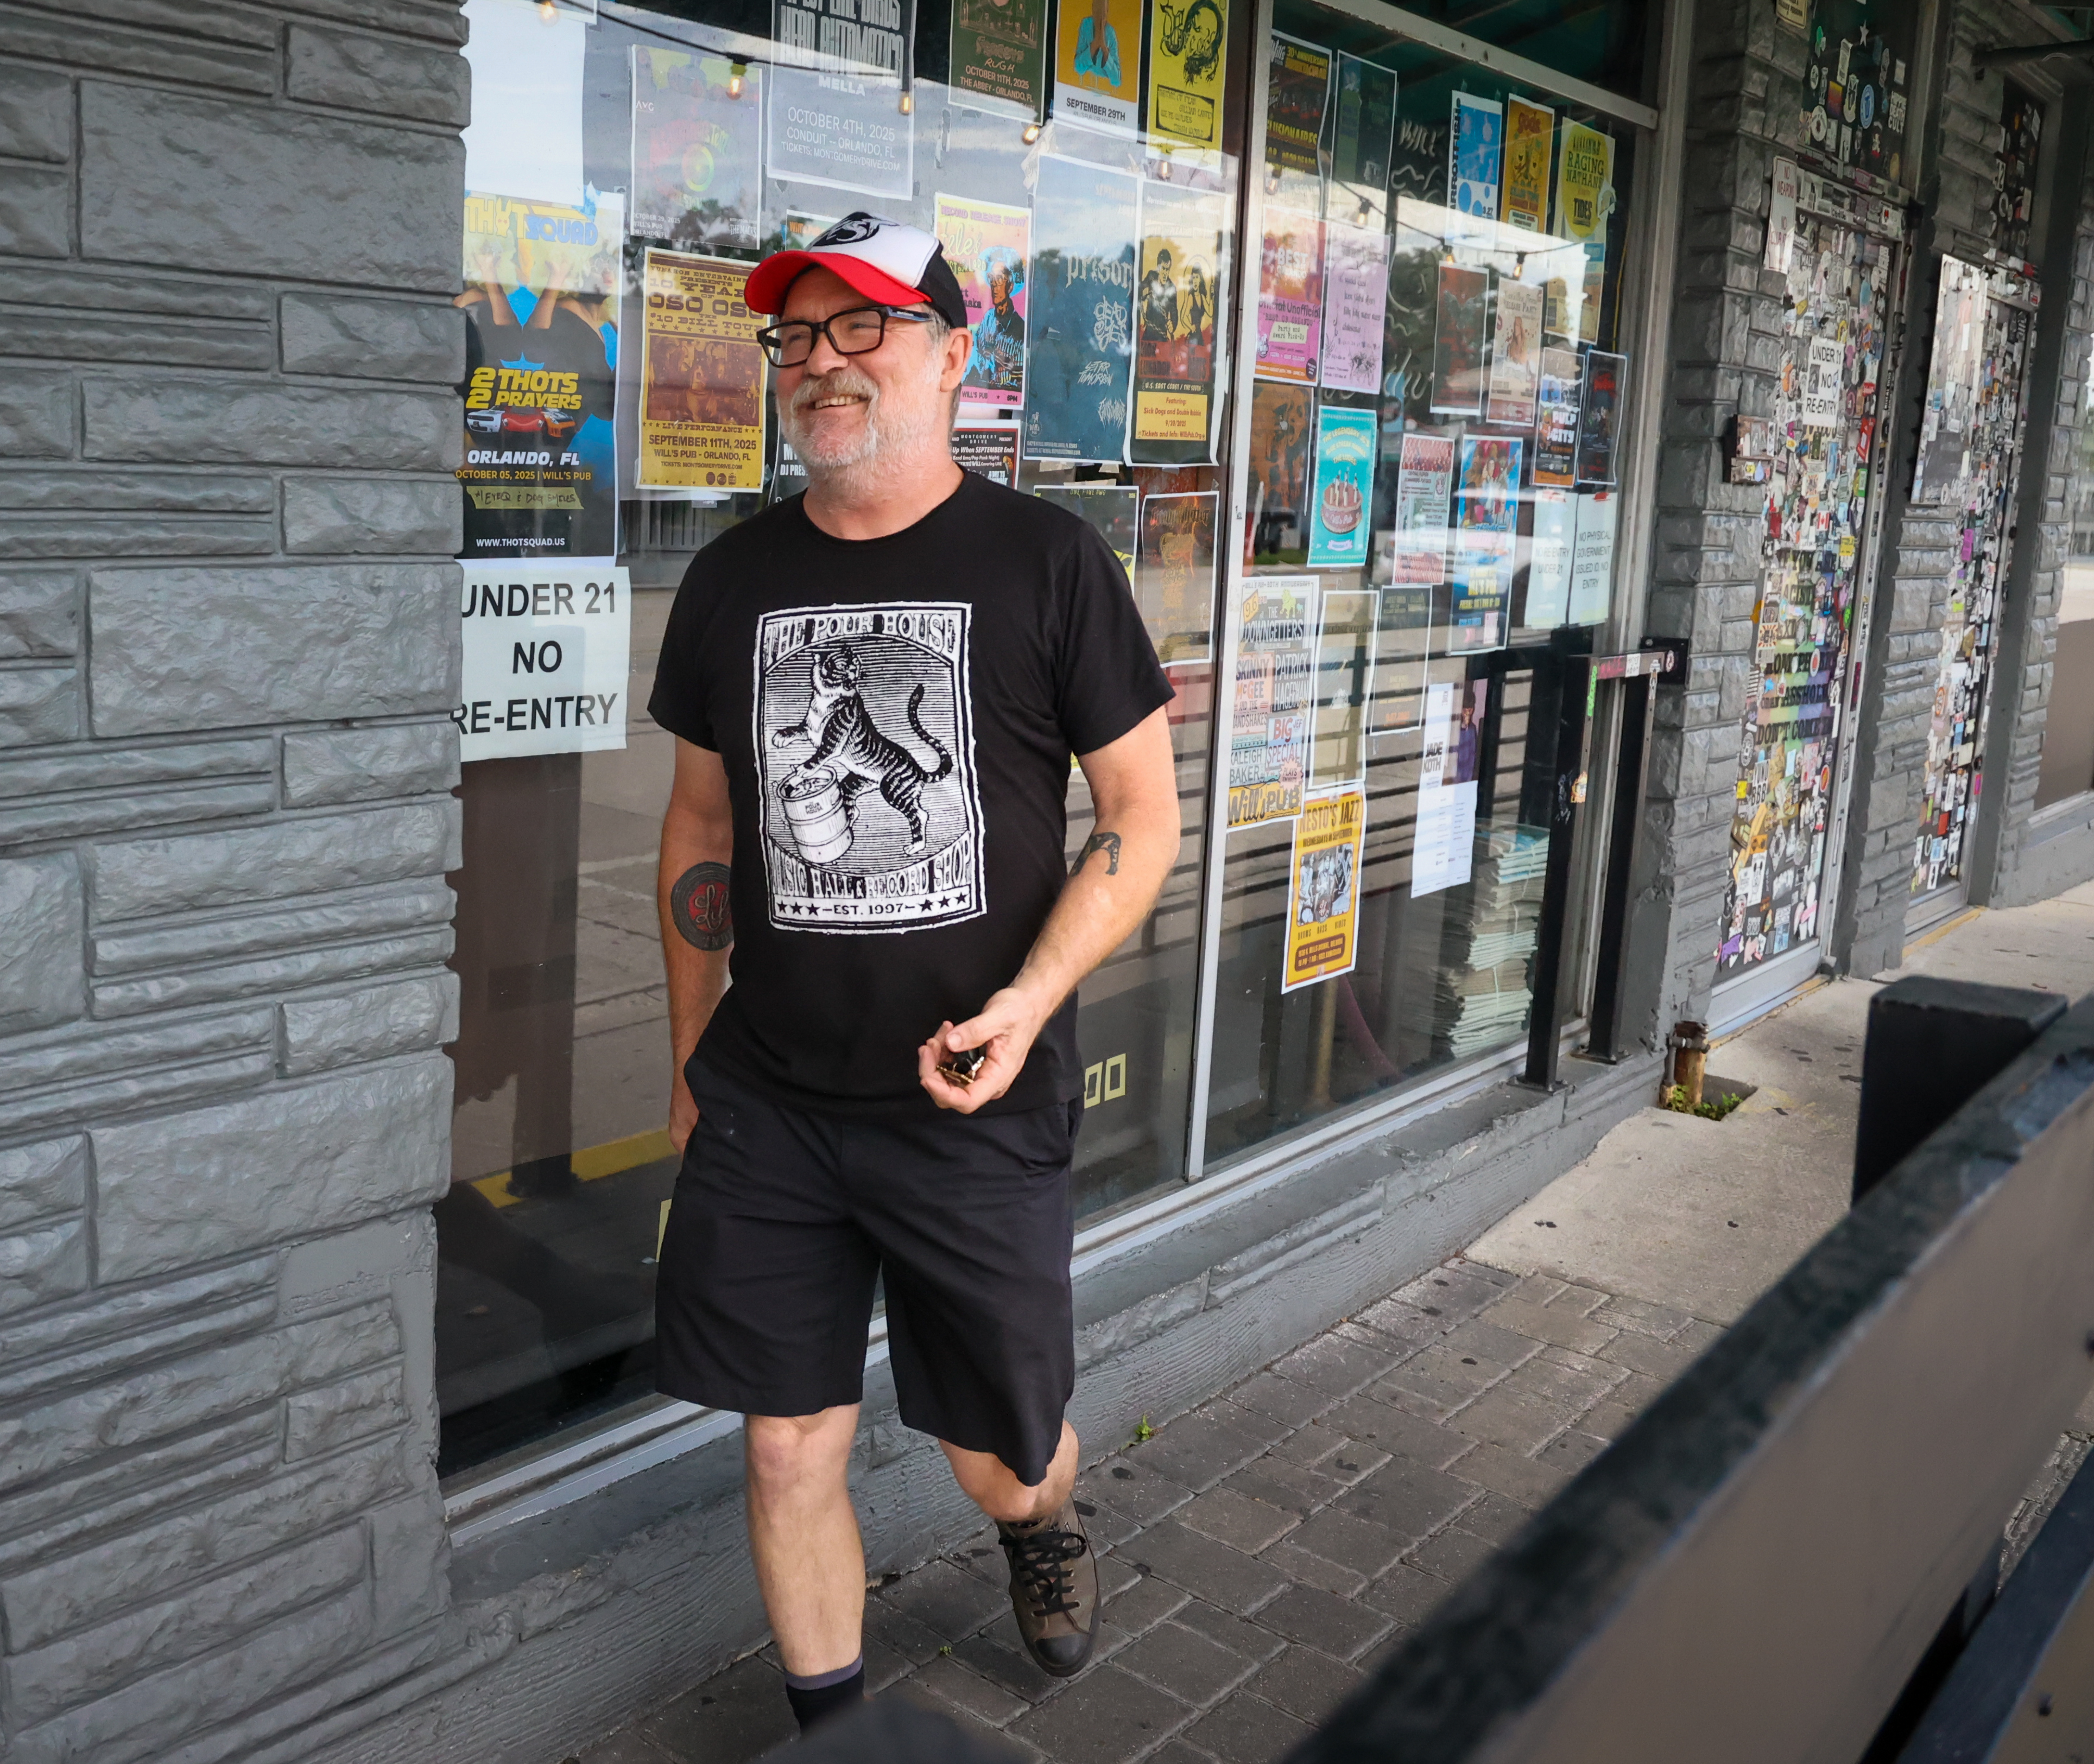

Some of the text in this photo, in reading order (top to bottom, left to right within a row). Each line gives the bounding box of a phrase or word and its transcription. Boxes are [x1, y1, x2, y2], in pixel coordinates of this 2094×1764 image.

[818, 74, 865, 97] MELLA
[965, 65, 1030, 90] OCTOBER 11TH, 2025
[960, 77, 972, 87] THE
[973, 79, 992, 92] ABBEY
[996, 86, 1027, 101] ORLANDO,
[1027, 94, 1033, 103] FL
[1066, 97, 1125, 121] SEPTEMBER 29TH
[788, 106, 895, 142] OCTOBER 4TH, 2025
[787, 126, 895, 158] CONDUIT ORLANDO, FL
[781, 141, 900, 172] TICKETS: MONTGOMERYDRIVE.COM
[1567, 150, 1604, 175] RAGING
[970, 210, 1002, 225] RELEASE
[1004, 216, 1027, 227] SHOW
[525, 213, 598, 246] SQUAD
[968, 258, 987, 272] LORD
[1277, 246, 1308, 269] BEST
[650, 278, 673, 289] 10
[680, 276, 733, 287] PRESENTS
[648, 291, 703, 313] OSO
[1287, 302, 1321, 319] Unofficial
[678, 316, 718, 327] BILL
[722, 321, 763, 332] TOUR
[1277, 325, 1290, 333] Party
[1287, 333, 1305, 341] Pick-Up
[1812, 344, 1836, 364] UNDER
[470, 367, 579, 394] 2 THOTS
[1821, 372, 1832, 389] NO
[466, 388, 583, 410] 2 PRAYERS
[962, 390, 988, 399] WILL'S PUB
[1166, 397, 1187, 406] Featuring:
[1155, 407, 1166, 416] Dogs
[1805, 397, 1837, 416] RE-ENTRY
[1552, 410, 1577, 426] PULP
[684, 424, 743, 433] PERFORMANCE
[1142, 429, 1159, 437] Tickets
[649, 434, 757, 450] SEPTEMBER 11TH, 2025
[952, 446, 960, 455] Up
[467, 450, 580, 467] ORLANDO, FL
[654, 449, 751, 462] WILL'S PUB ORLANDO, FL
[456, 469, 592, 481] OCTOBER 05, 2025 WILL'S PUB
[780, 465, 790, 475] DJ
[476, 538, 566, 548] WWW.THOTSQUAD.US
[1579, 530, 1611, 542] NO PHYSICAL
[1552, 547, 1570, 557] ENTRY
[1577, 545, 1611, 558] GOVERNMENT
[1538, 563, 1563, 574] UNDER 21
[1576, 561, 1609, 574] ISSUED NO
[1583, 578, 1599, 589] ENTRY
[461, 582, 615, 618] UNDER 21
[1245, 595, 1258, 618] 9.6
[1268, 606, 1279, 618] THE
[1244, 619, 1304, 643] DOWNGETTERS
[764, 613, 957, 672] THE POUR HOUSE
[513, 640, 562, 674] NO
[1236, 658, 1270, 681] SKINNY
[1275, 651, 1309, 681] PATRICK
[455, 693, 618, 735] RE-ENTRY
[1273, 717, 1293, 743] BIG
[1756, 721, 1791, 745] DON'T
[1267, 742, 1300, 765] SPECIAL
[1425, 741, 1444, 758] JADE
[1230, 765, 1260, 785] BAKER
[1283, 767, 1298, 777] PLAYS
[805, 803, 820, 811] POUR
[1228, 786, 1301, 826] Will's PUB
[1299, 799, 1360, 834] NESTO'S JAZZ
[813, 866, 855, 899] HALL
[866, 861, 930, 899] RECORD
[932, 831, 972, 887] SHOP
[834, 903, 904, 916] EST. 1997
[1298, 923, 1327, 941] DRUMS BASS
